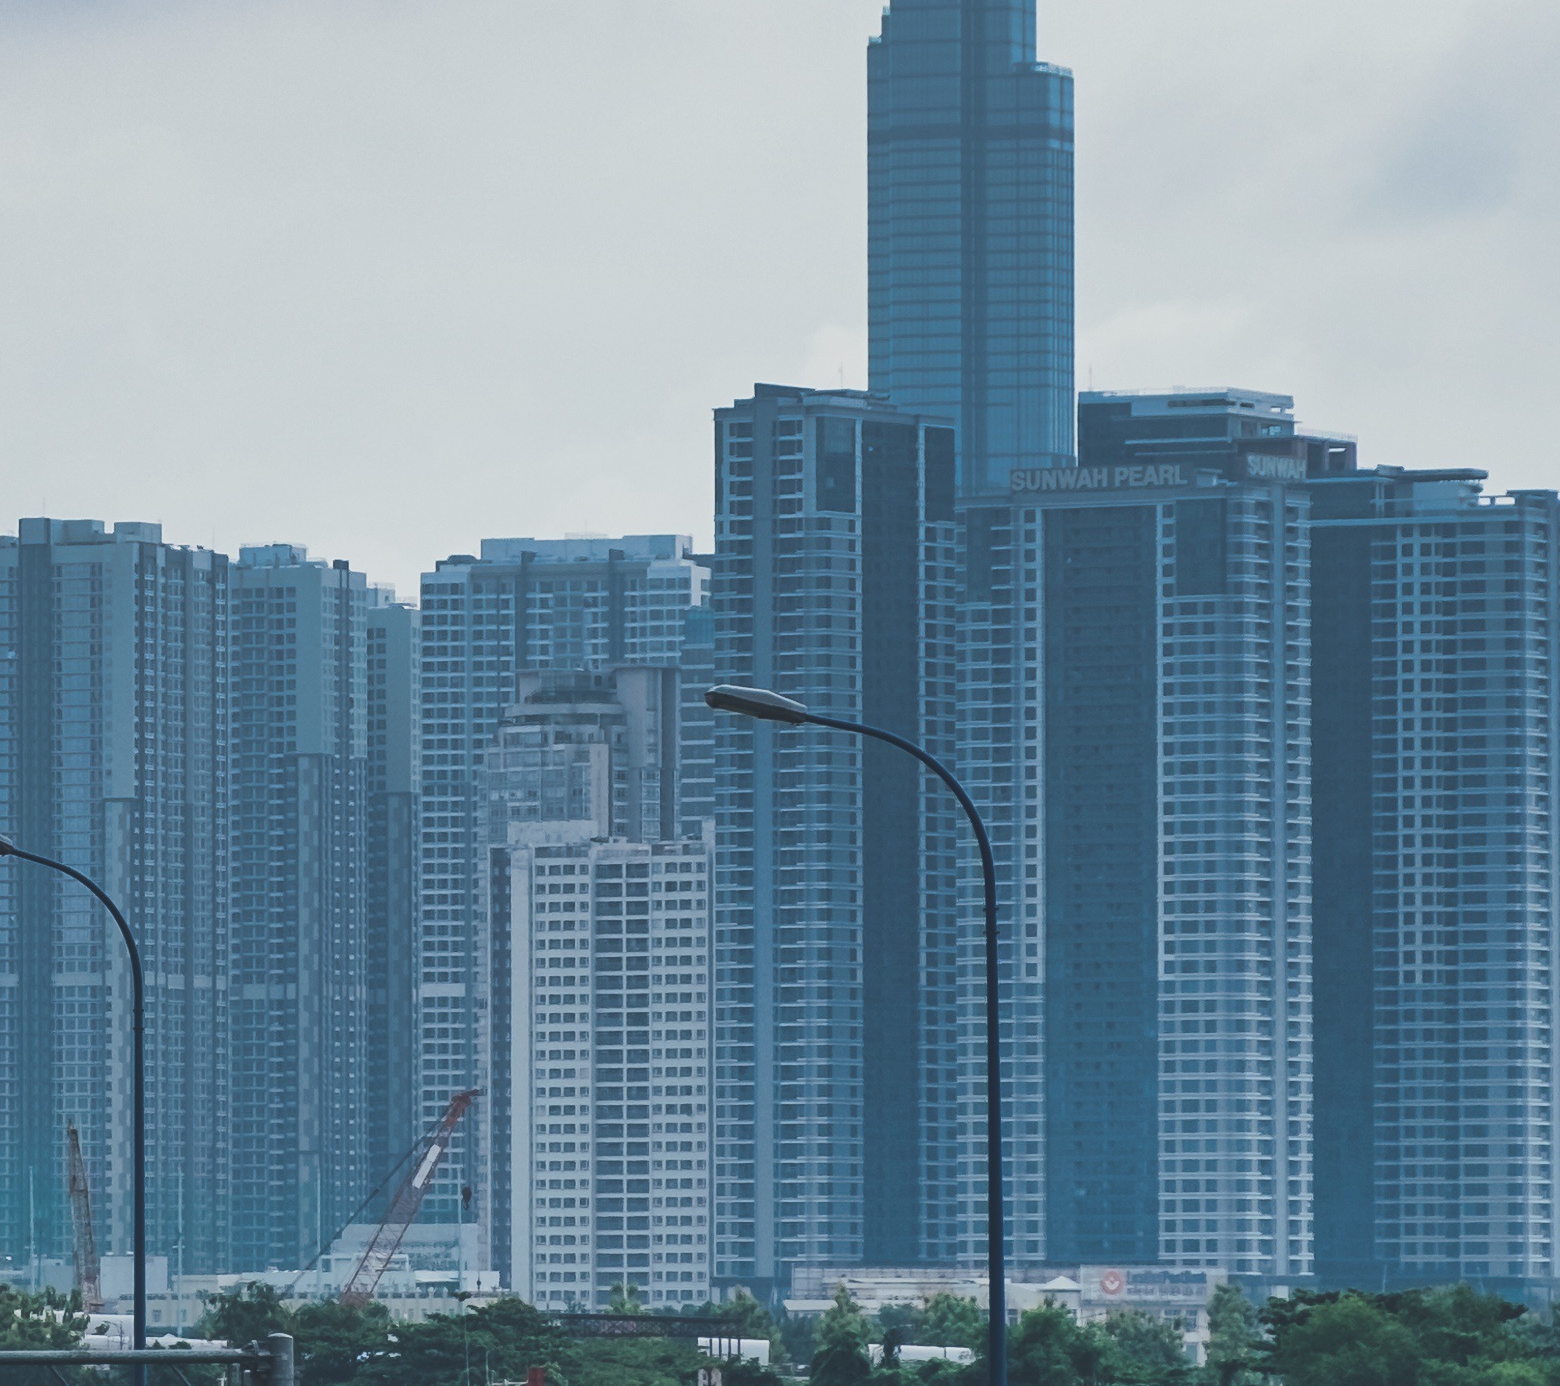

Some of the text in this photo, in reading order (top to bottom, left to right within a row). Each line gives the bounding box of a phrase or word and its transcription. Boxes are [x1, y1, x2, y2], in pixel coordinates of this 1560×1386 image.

[1011, 464, 1188, 492] SUNWAH PEARL
[1247, 455, 1307, 480] SUNWAH
